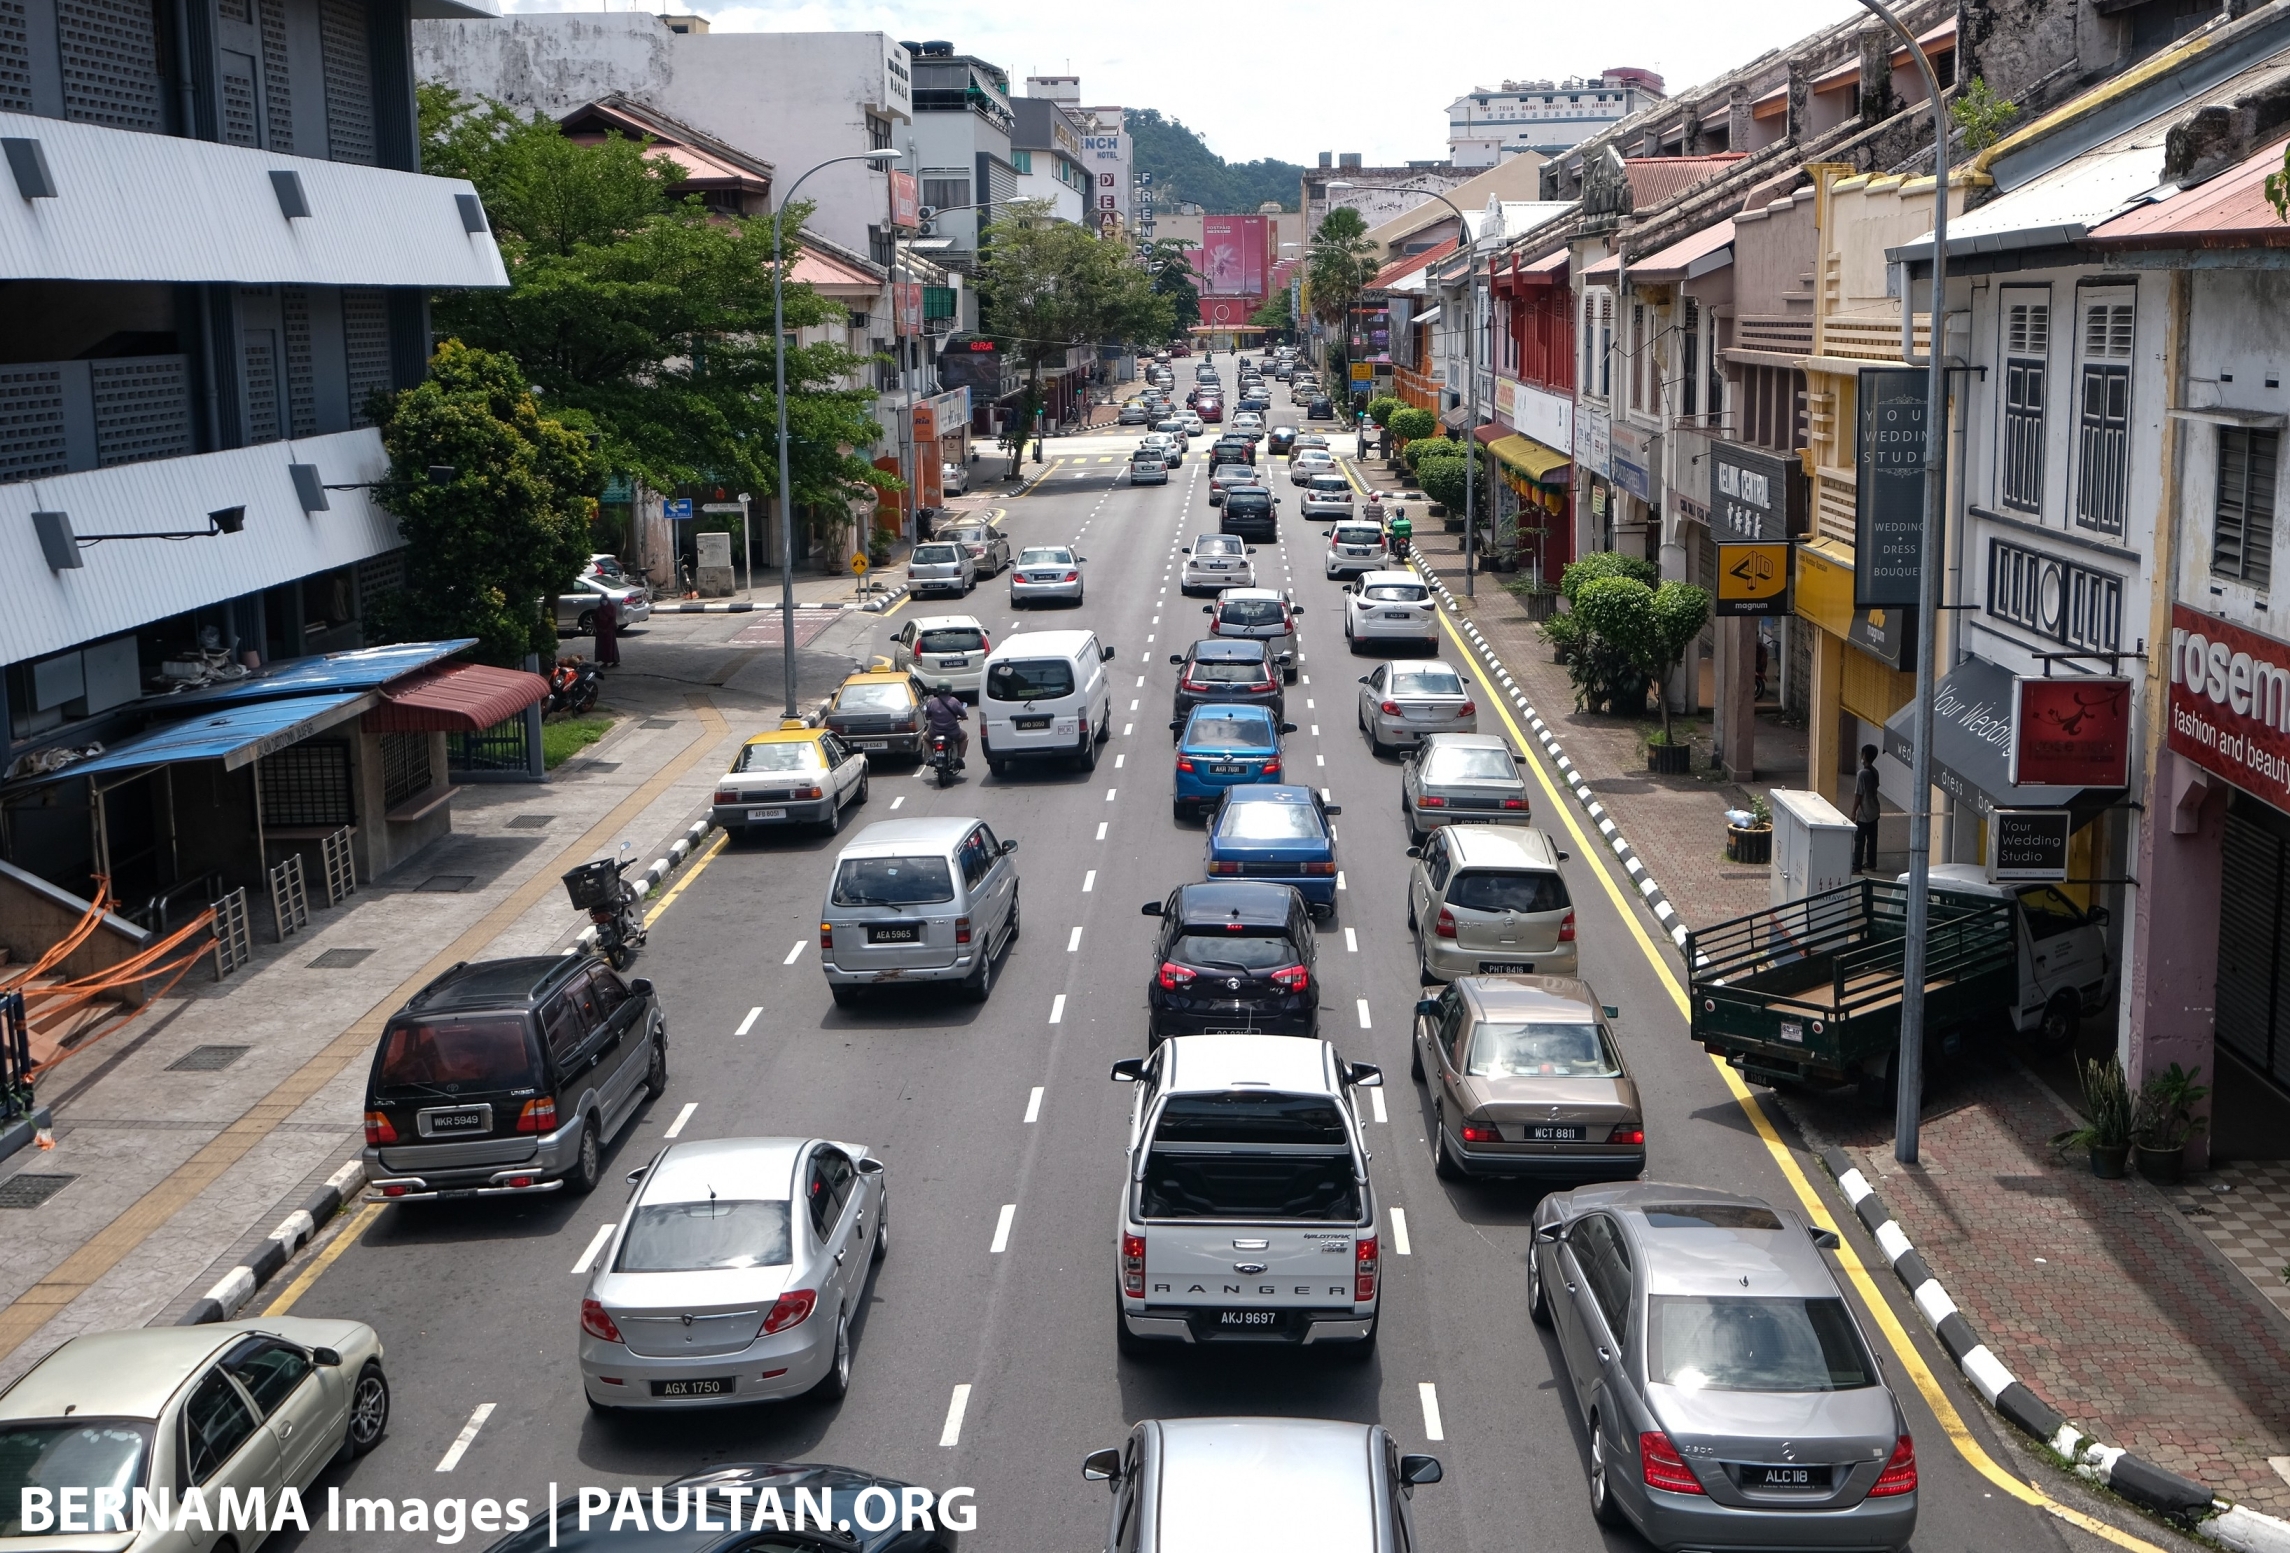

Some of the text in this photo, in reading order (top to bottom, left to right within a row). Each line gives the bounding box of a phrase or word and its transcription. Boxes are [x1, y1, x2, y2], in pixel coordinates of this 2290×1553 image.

[1097, 151, 1118, 159] HOTEL
[915, 416, 930, 425] Ria
[1866, 410, 1921, 421] YOU
[1865, 431, 1928, 442] WEDDIN
[1864, 451, 1927, 463] STUDI
[1741, 470, 1771, 509] CENTRAL
[1883, 545, 1916, 554] DRESS
[1735, 603, 1768, 611] magnum
[1866, 625, 1885, 643] magnum
[2171, 627, 2290, 733] rosem
[1934, 684, 1965, 718] Your
[1021, 721, 1032, 729] AHD
[2174, 702, 2216, 748] fashion
[2220, 732, 2244, 763] and
[1941, 770, 1964, 796] dress
[767, 809, 780, 817] 8051
[2002, 820, 2031, 832] Your
[2002, 834, 2061, 847] Wedding
[2001, 850, 2043, 861] Studio
[876, 929, 911, 939] AEA 5965
[1489, 965, 1524, 973] PHT 8416
[1750, 1073, 1767, 1085] 1394
[434, 1115, 479, 1127] WKR 5949
[1535, 1127, 1575, 1139] WCT 8811
[1154, 1284, 1346, 1296] RANGER
[1221, 1311, 1276, 1323] AKJ 9697
[665, 1381, 720, 1394] AGX 1750
[1766, 1470, 1808, 1482] ALC 118
